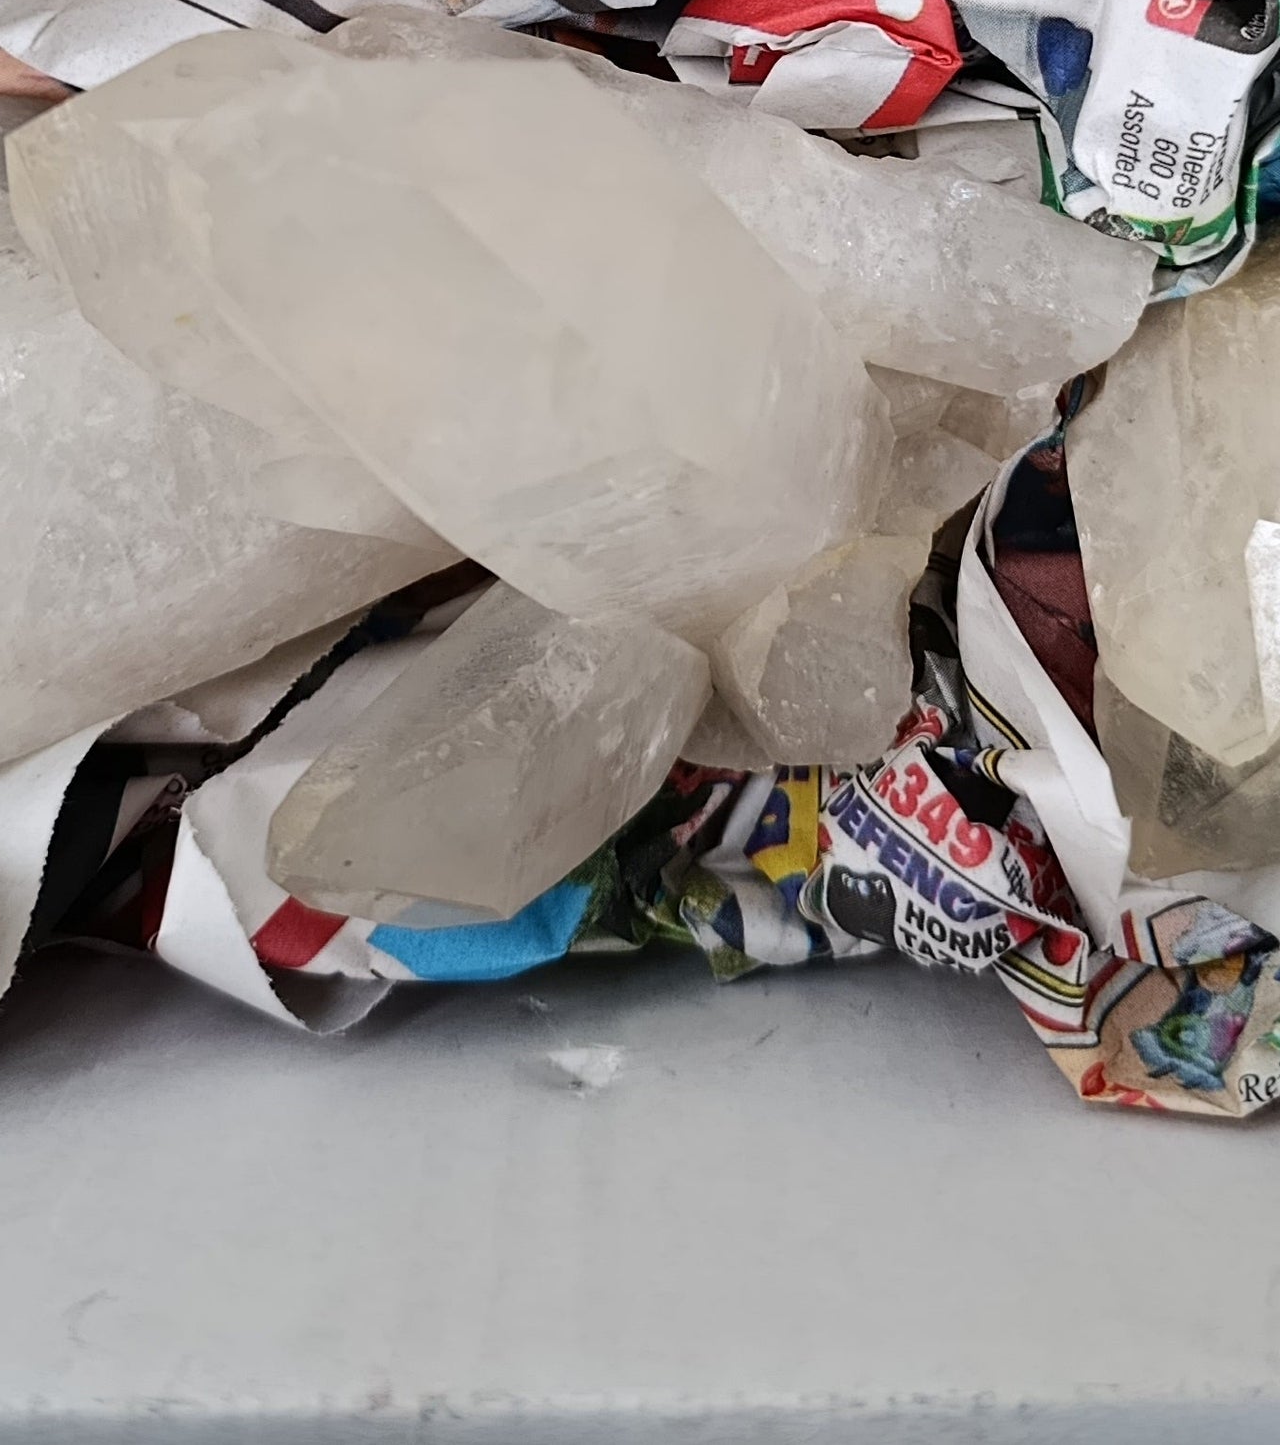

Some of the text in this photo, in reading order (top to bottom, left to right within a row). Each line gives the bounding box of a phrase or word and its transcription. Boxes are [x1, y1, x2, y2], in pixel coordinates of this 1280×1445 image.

[1111, 89, 1155, 189] Assorted
[1138, 137, 1179, 200] 600 g
[1172, 131, 1216, 209] Cheese
[905, 900, 1011, 959] HORNS
